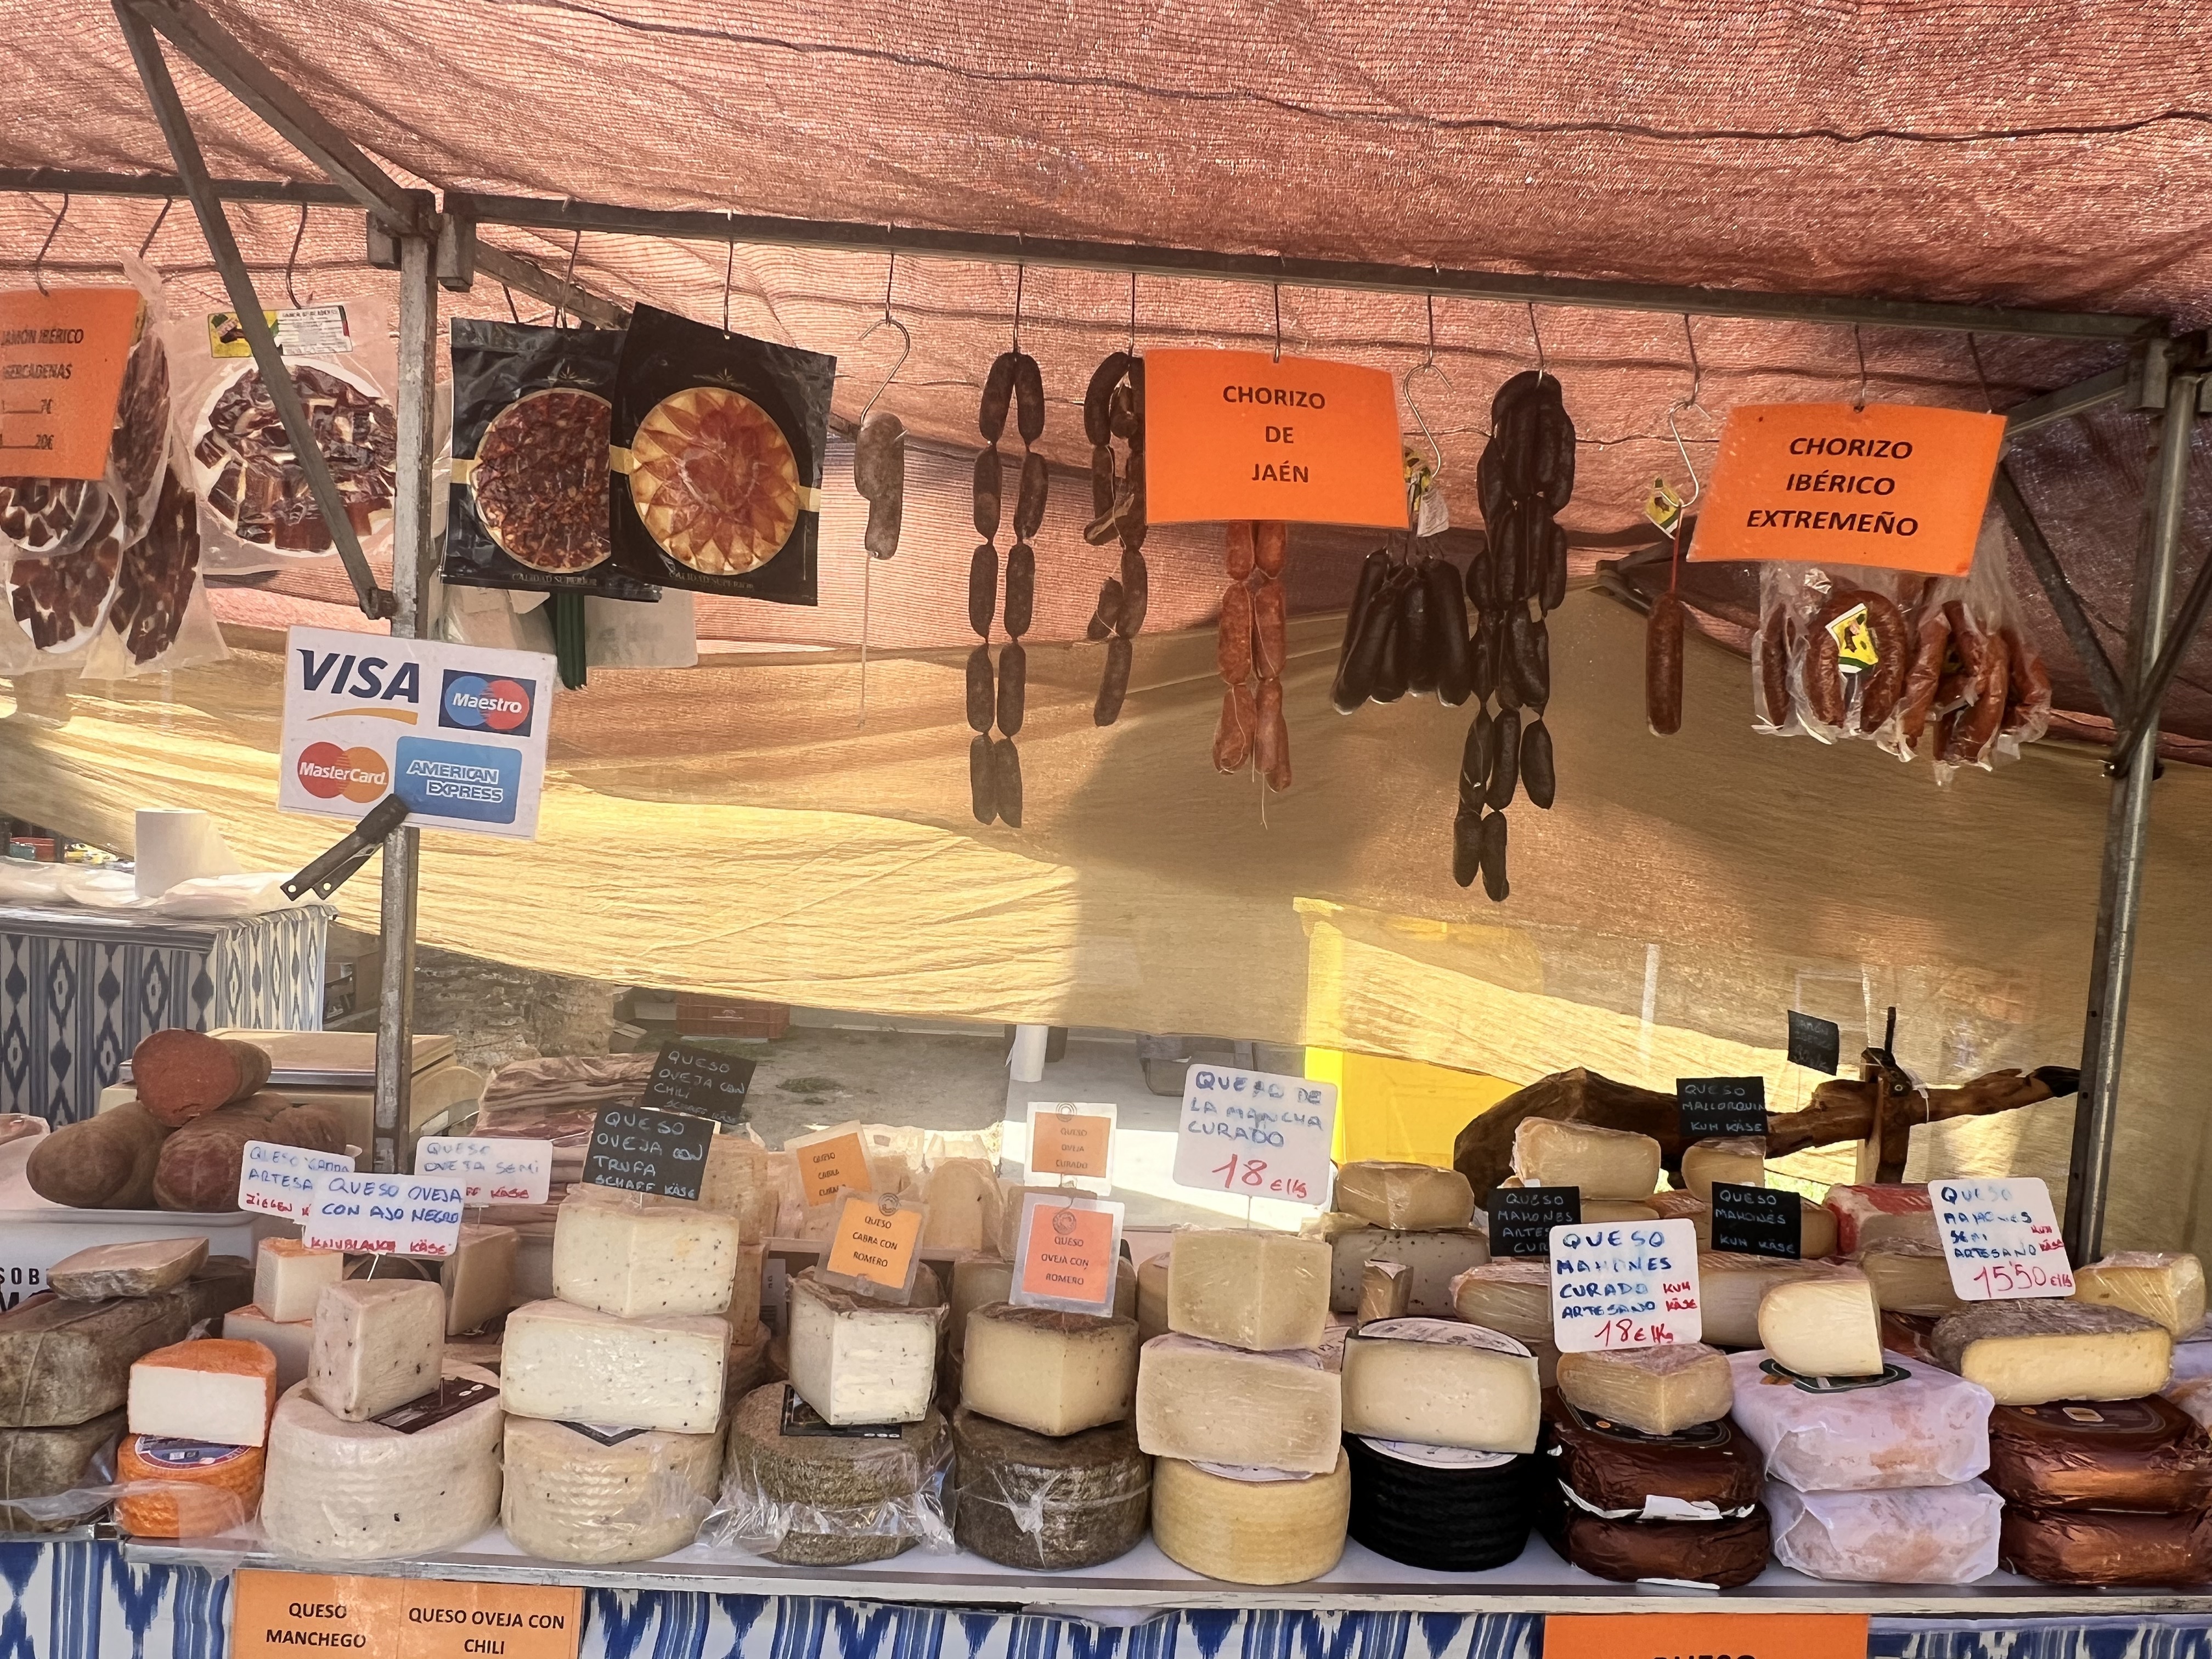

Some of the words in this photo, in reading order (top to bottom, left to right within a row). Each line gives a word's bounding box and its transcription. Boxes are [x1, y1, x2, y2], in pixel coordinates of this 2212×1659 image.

[1223, 386, 1325, 409] CHORIZO
[1265, 426, 1294, 444] DE
[1790, 437, 1913, 459] CHORIZO
[1251, 460, 1309, 483] JAÉN
[1786, 470, 1895, 495] IBÉRICO
[1747, 510, 1918, 536] EXTREMEÑO
[296, 648, 419, 703] VISA
[452, 692, 522, 714] Maestro
[299, 761, 387, 786] MasterCard
[407, 759, 499, 785] AMERICAN
[426, 780, 503, 803] EXPRESS
[668, 1051, 730, 1073] QUESO
[659, 1069, 712, 1088] OVEJA
[1195, 1071, 1284, 1098] QUESO
[1297, 1087, 1322, 1104] DE
[1685, 1084, 1745, 1096] QUESO
[605, 1111, 685, 1135] QUESO
[1190, 1097, 1217, 1114] LA
[1226, 1106, 1324, 1131] MANCHA
[1188, 1120, 1284, 1147] CURADO
[1690, 1121, 1719, 1131] KUH
[597, 1132, 663, 1156] OVEJA
[593, 1155, 656, 1177] TRUFA
[248, 1169, 313, 1190] ARTESA
[329, 1177, 400, 1198] QUESO
[408, 1186, 464, 1203] OVEJA
[1506, 1193, 1564, 1206] QUESO
[1720, 1189, 1776, 1205] QUESO
[321, 1203, 360, 1216] CON
[370, 1208, 404, 1221] AJO
[411, 1209, 459, 1224] NEGRO
[865, 1216, 892, 1229] QUESO
[853, 1232, 878, 1244] CABRA
[880, 1239, 898, 1250] CON
[1054, 1236, 1084, 1247] QUESO
[1514, 1242, 1549, 1253] CUR
[1562, 1230, 1664, 1249] QUESO
[1720, 1234, 1748, 1247] KUH
[853, 1251, 888, 1267] ROMERO
[1041, 1253, 1068, 1265] OVEJA
[1070, 1257, 1089, 1268] CON
[1954, 1244, 2036, 1259] ARTESANO
[1046, 1273, 1084, 1285] ROMERO
[1559, 1282, 1648, 1299] CURADO
[1663, 1281, 1691, 1294] KUH
[1561, 1301, 1656, 1319] ARTESANO
[289, 1602, 347, 1620] QUESO
[409, 1607, 467, 1624] QUESO
[472, 1611, 523, 1628] OVEJA
[528, 1614, 565, 1630] CON
[266, 1629, 366, 1649] MANCHEGO
[464, 1638, 505, 1655] CHILI
